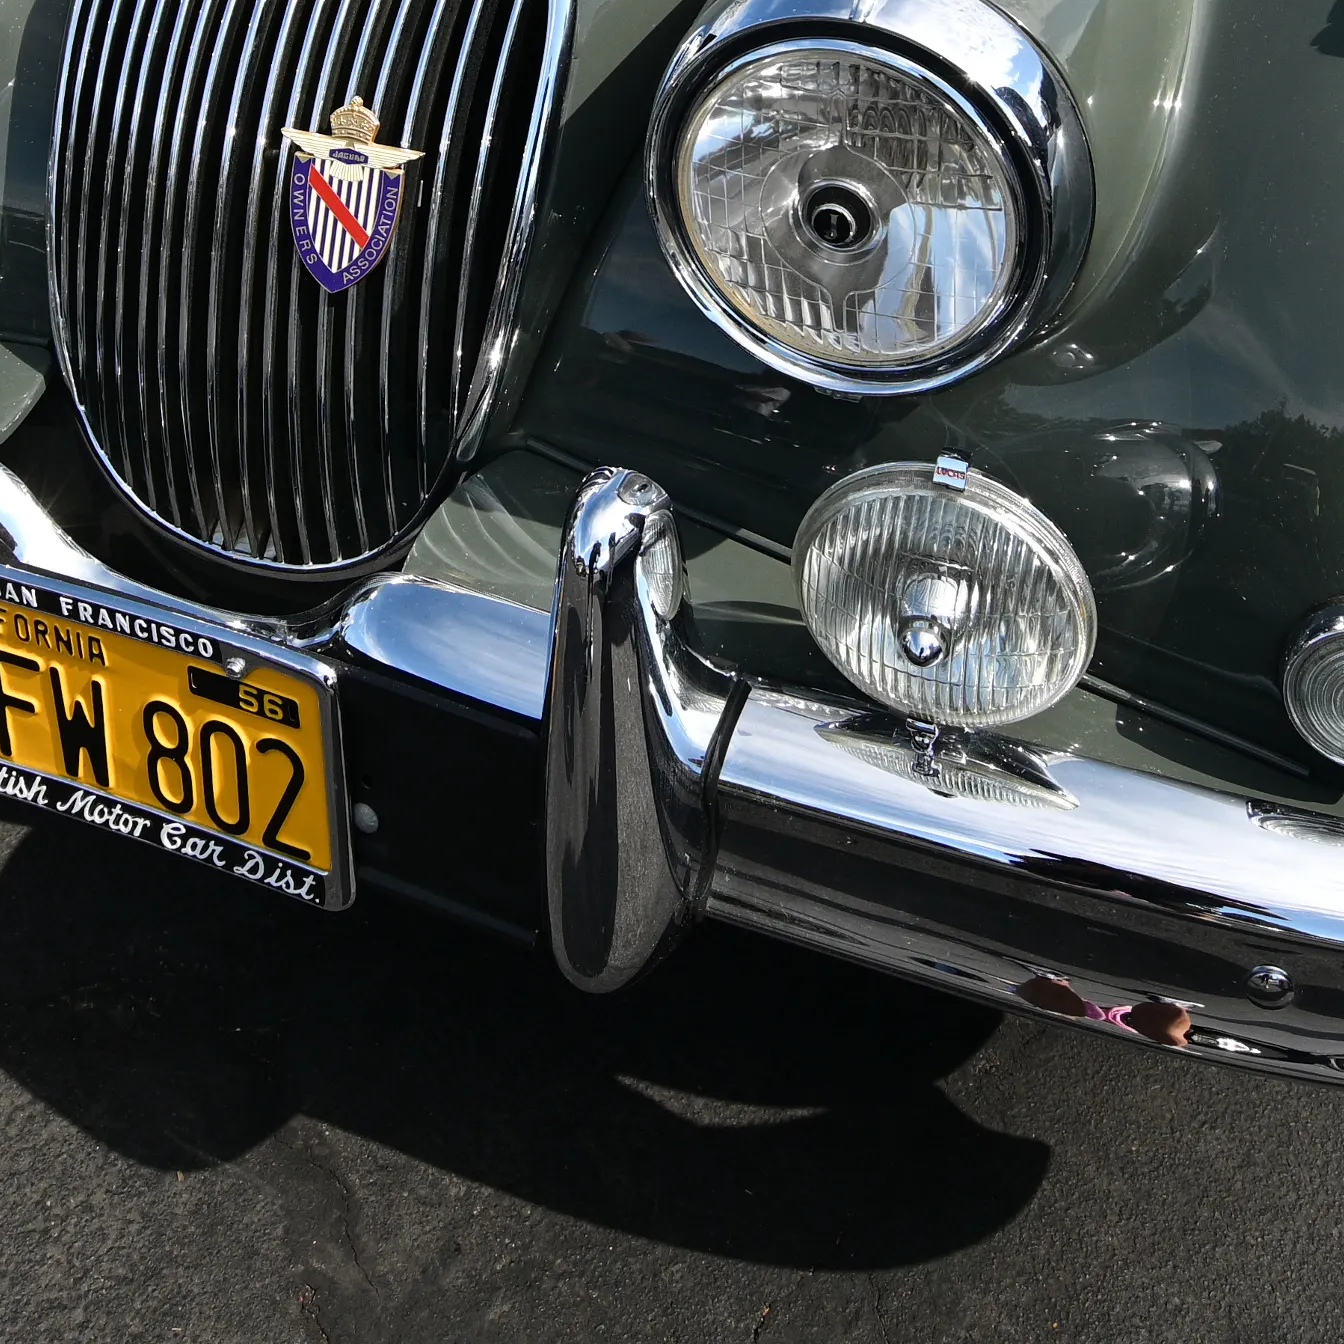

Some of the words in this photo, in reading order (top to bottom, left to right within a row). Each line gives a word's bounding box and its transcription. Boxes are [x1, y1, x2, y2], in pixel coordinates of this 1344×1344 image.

[292, 172, 318, 266] OWNERS
[342, 186, 400, 285] ASSOCIATION
[936, 465, 966, 480] LUCAS
[60, 596, 214, 658] FRANCISCO
[238, 684, 285, 720] 56
[142, 699, 312, 862] 802
[56, 791, 151, 837] Motor
[159, 822, 226, 869] Car
[233, 850, 320, 904] Dist.
